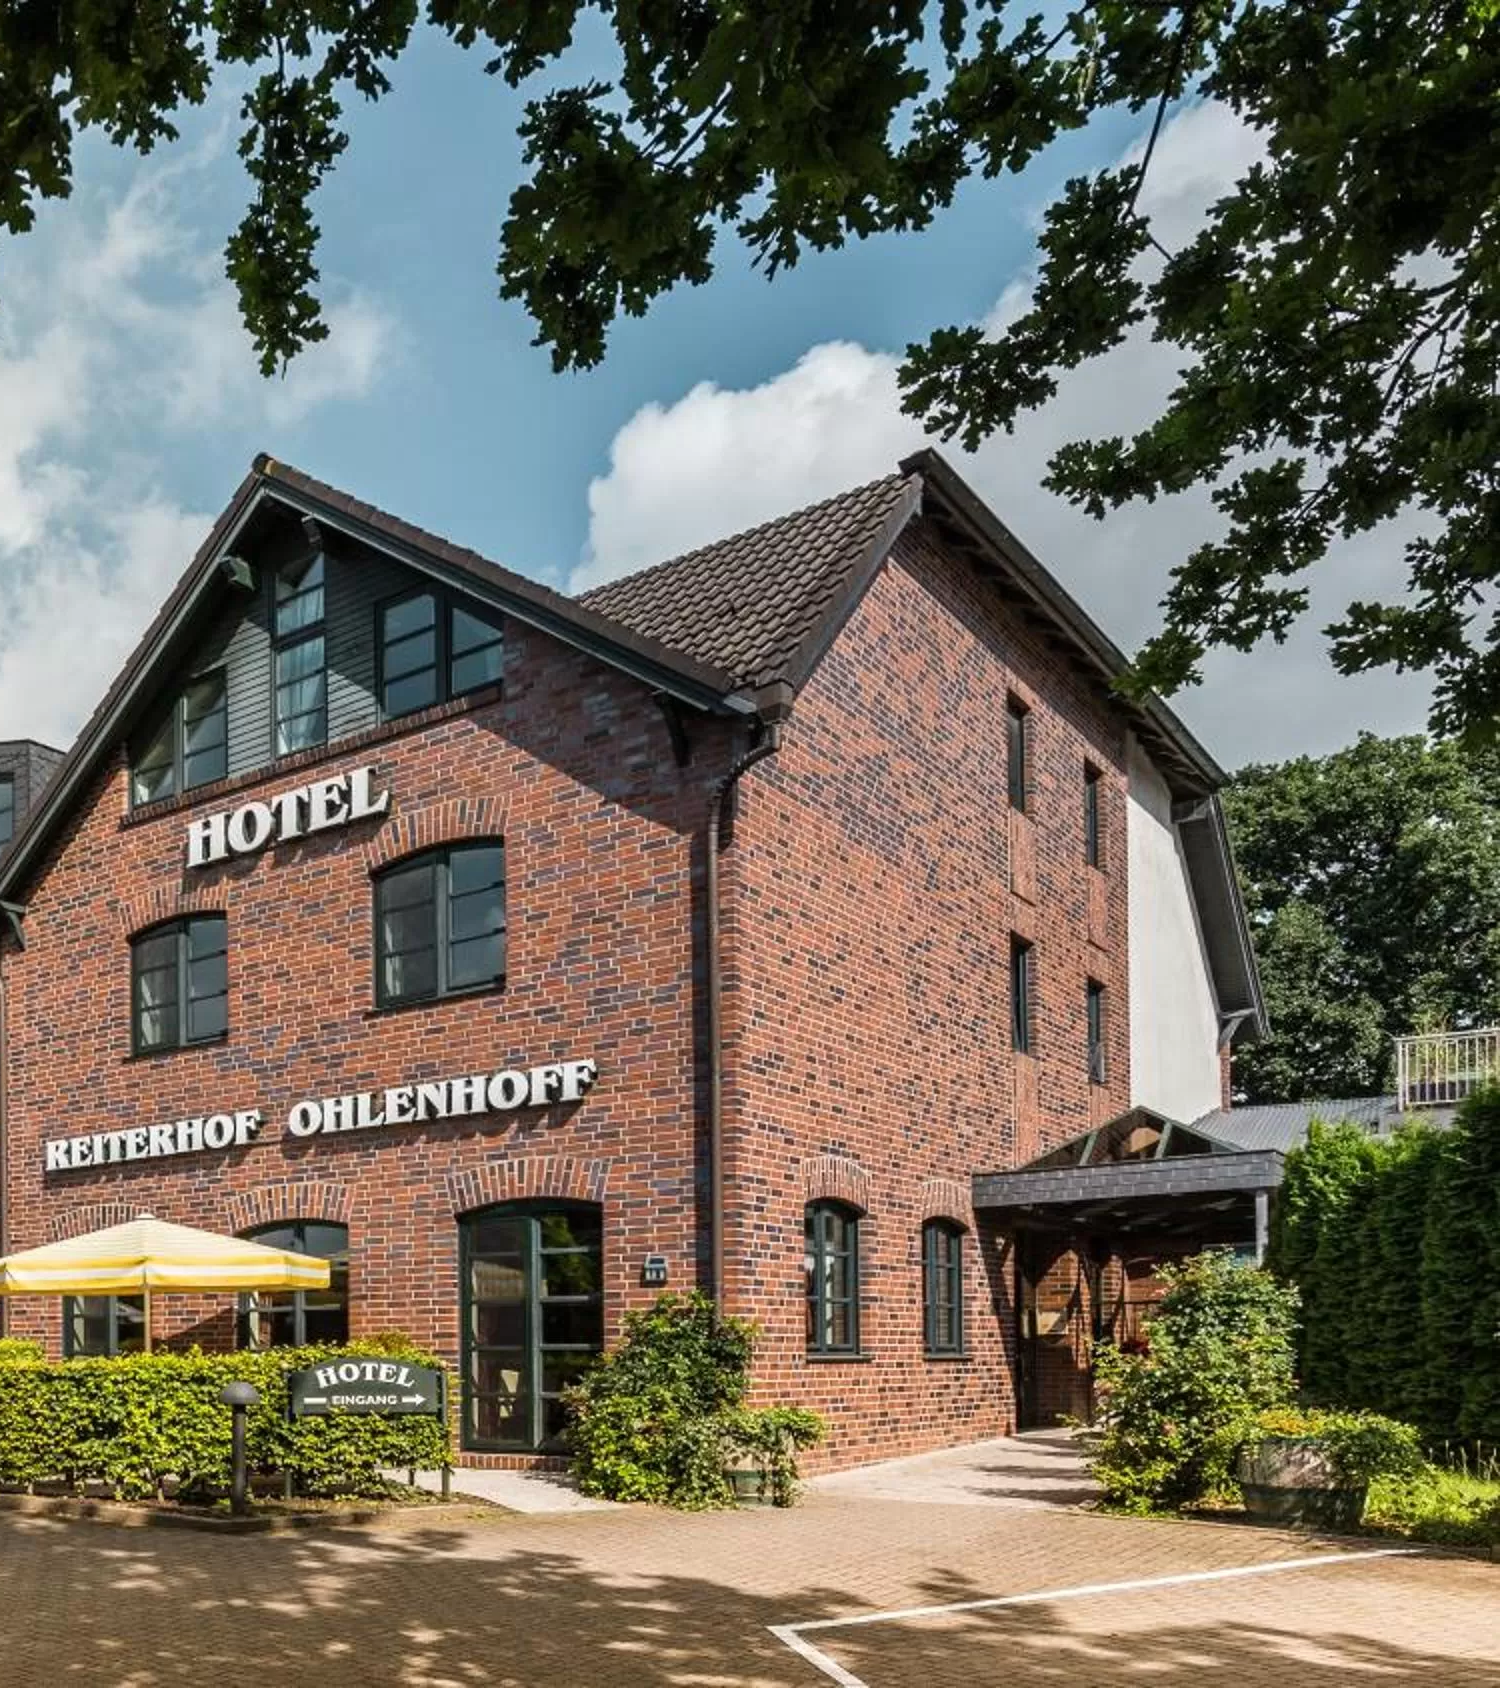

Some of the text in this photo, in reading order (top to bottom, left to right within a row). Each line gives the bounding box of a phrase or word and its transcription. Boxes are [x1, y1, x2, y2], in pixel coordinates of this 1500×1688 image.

[187, 766, 390, 867] HOTEL
[46, 1059, 596, 1171] REITERHOF OHLENHOFF
[315, 1362, 415, 1388] HOTEL
[331, 1395, 397, 1405] EINGANG
